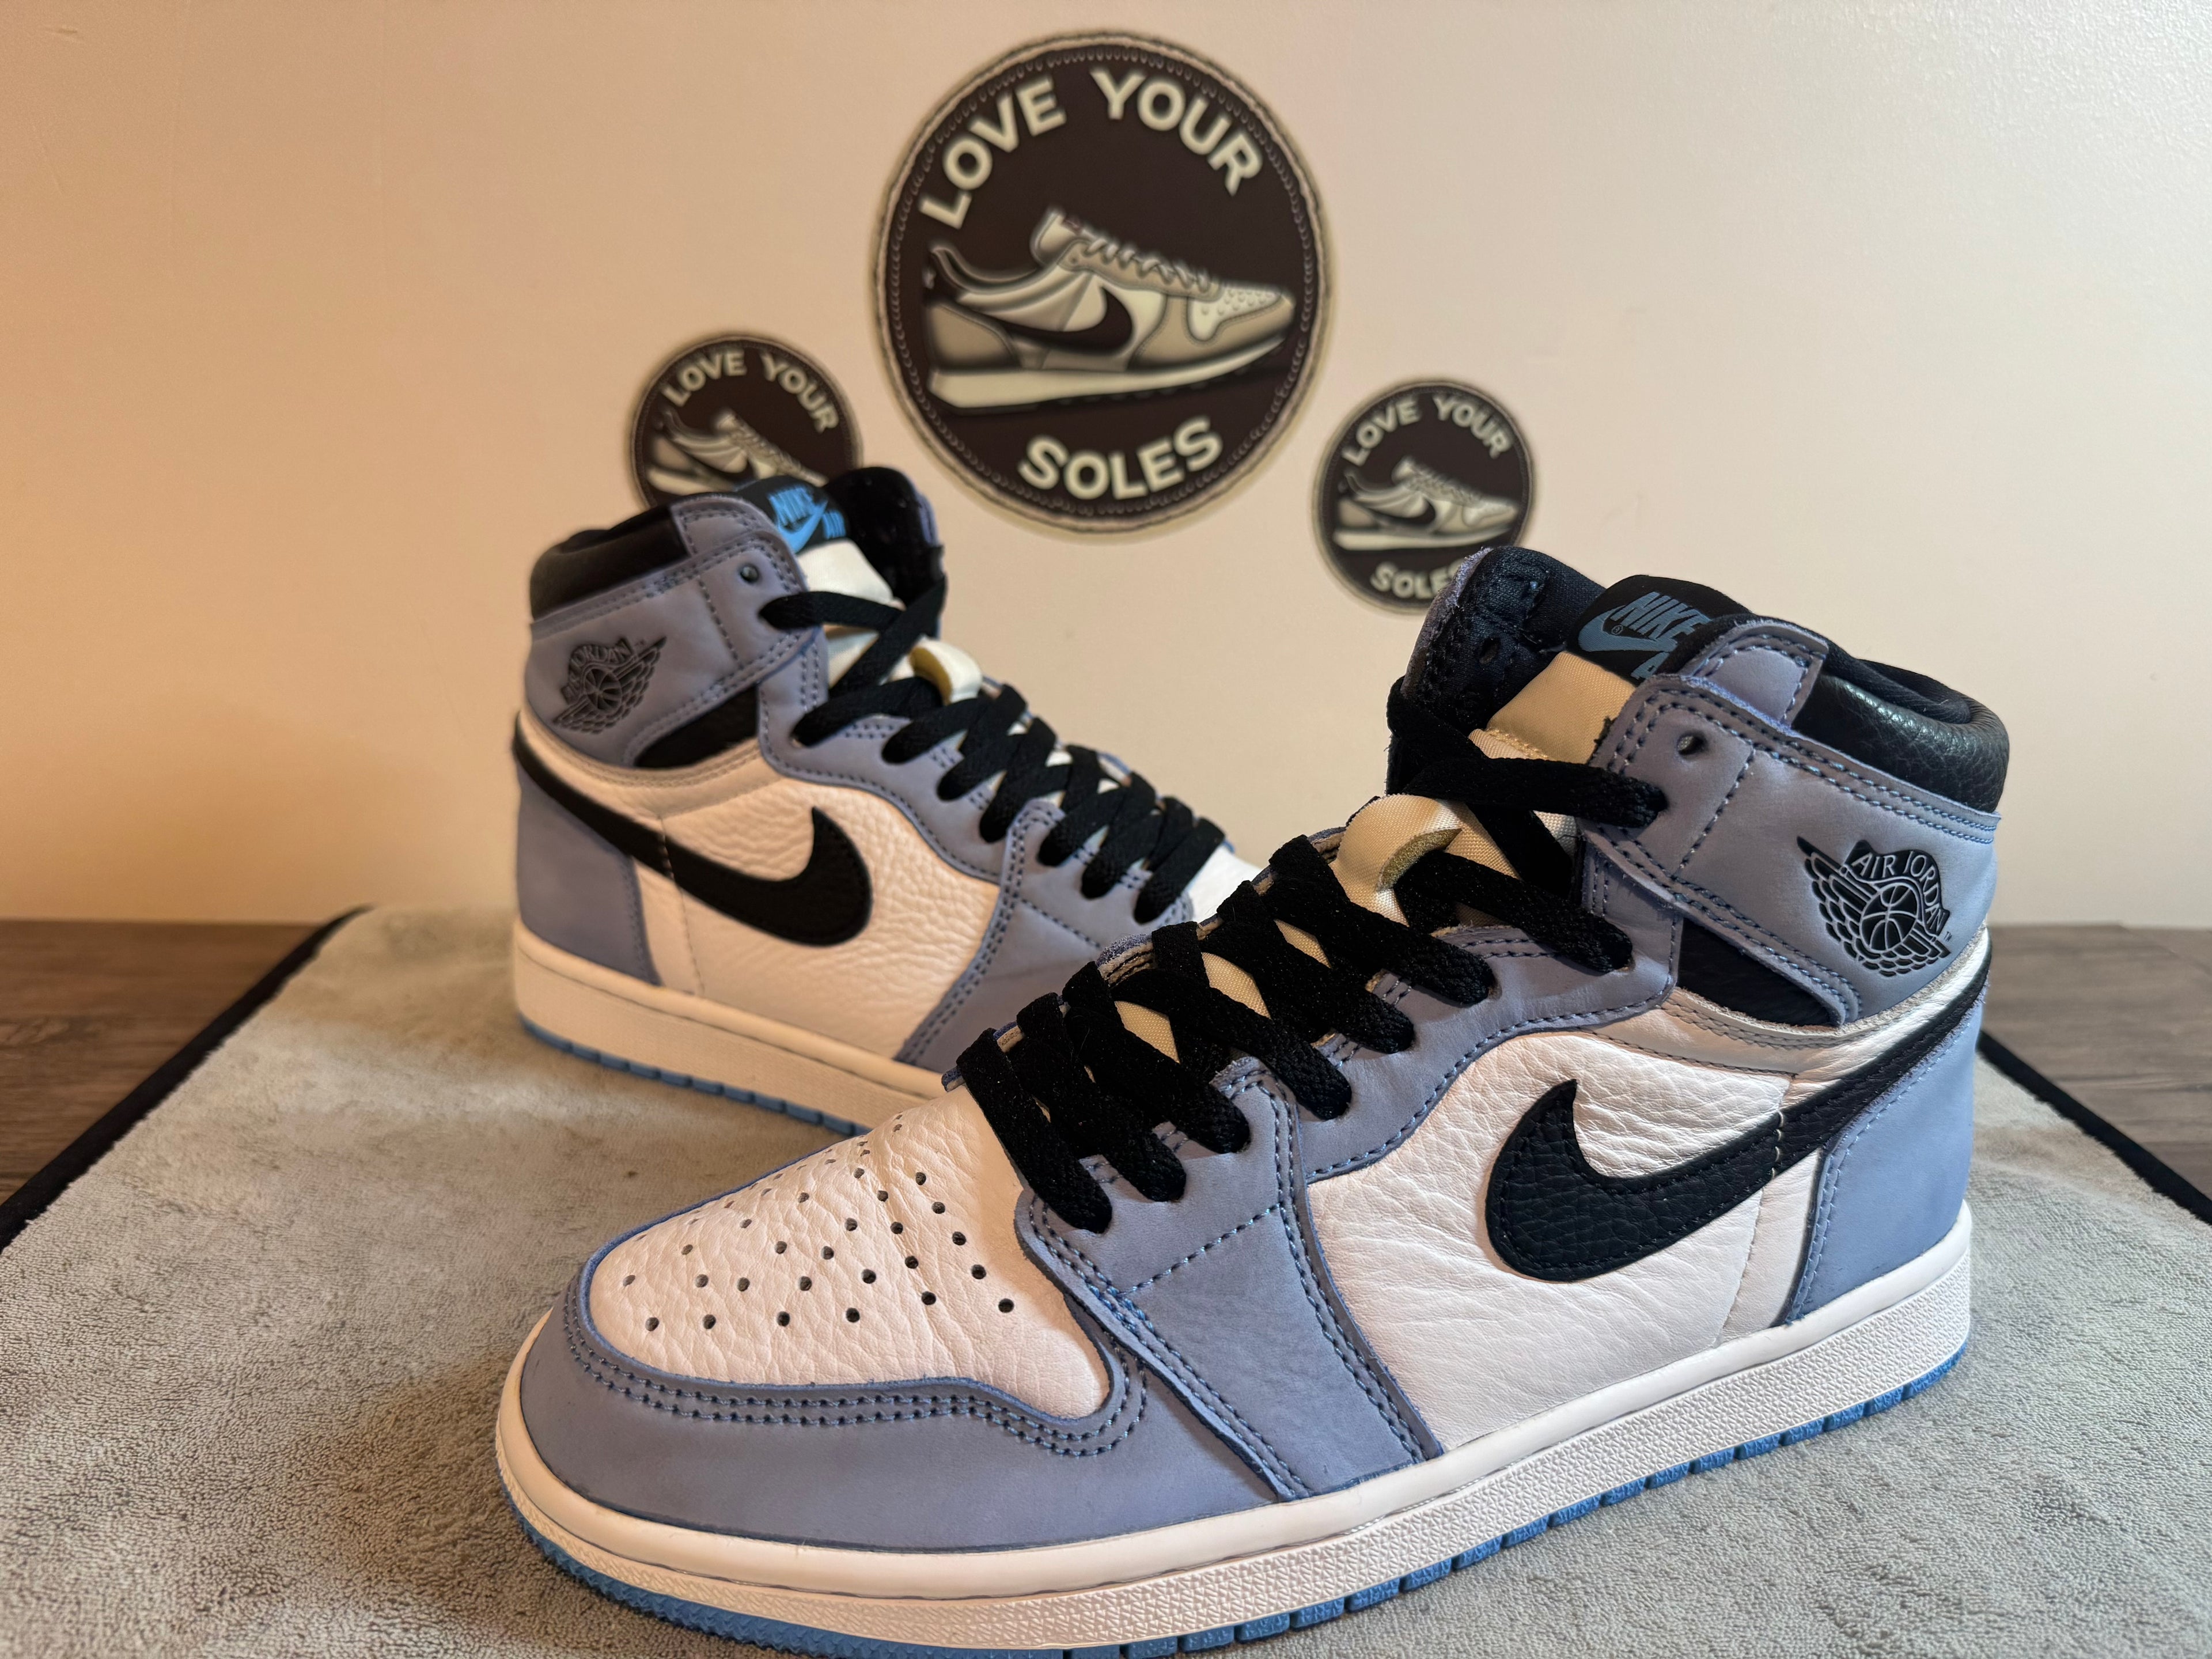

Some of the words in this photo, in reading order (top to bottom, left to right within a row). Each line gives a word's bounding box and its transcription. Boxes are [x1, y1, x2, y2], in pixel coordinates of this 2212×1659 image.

[919, 77, 1067, 229] LOVE
[1090, 67, 1264, 196] YOUR
[661, 350, 747, 407] LOVE
[760, 353, 839, 433] YOUR
[1341, 396, 1420, 467] LOVE
[1433, 395, 1513, 459] YOUR
[1019, 415, 1223, 500] SOLES
[1370, 558, 1465, 600] SOLE
[1610, 591, 1713, 641] NIKE
[1851, 852, 1897, 878] AIR
[1902, 850, 1946, 930] JORDAN
